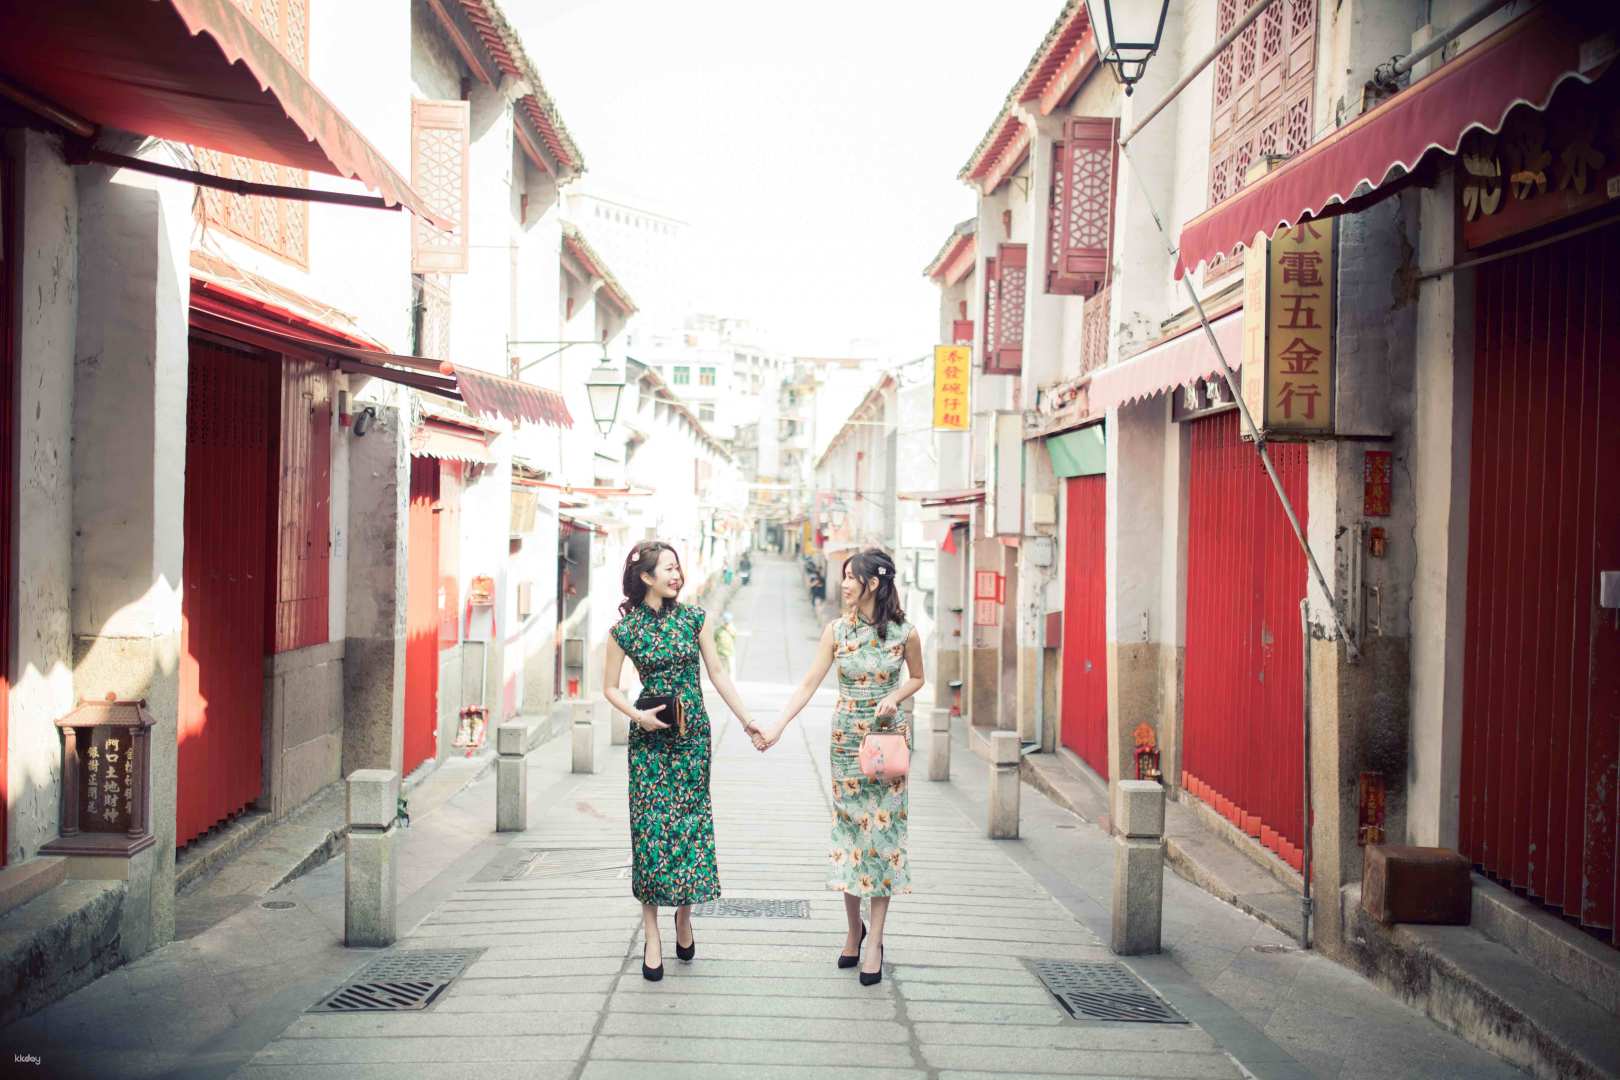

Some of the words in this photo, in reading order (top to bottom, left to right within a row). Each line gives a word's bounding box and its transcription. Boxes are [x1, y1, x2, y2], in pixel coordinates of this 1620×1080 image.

[104, 739, 120, 824] 門口土地財神
